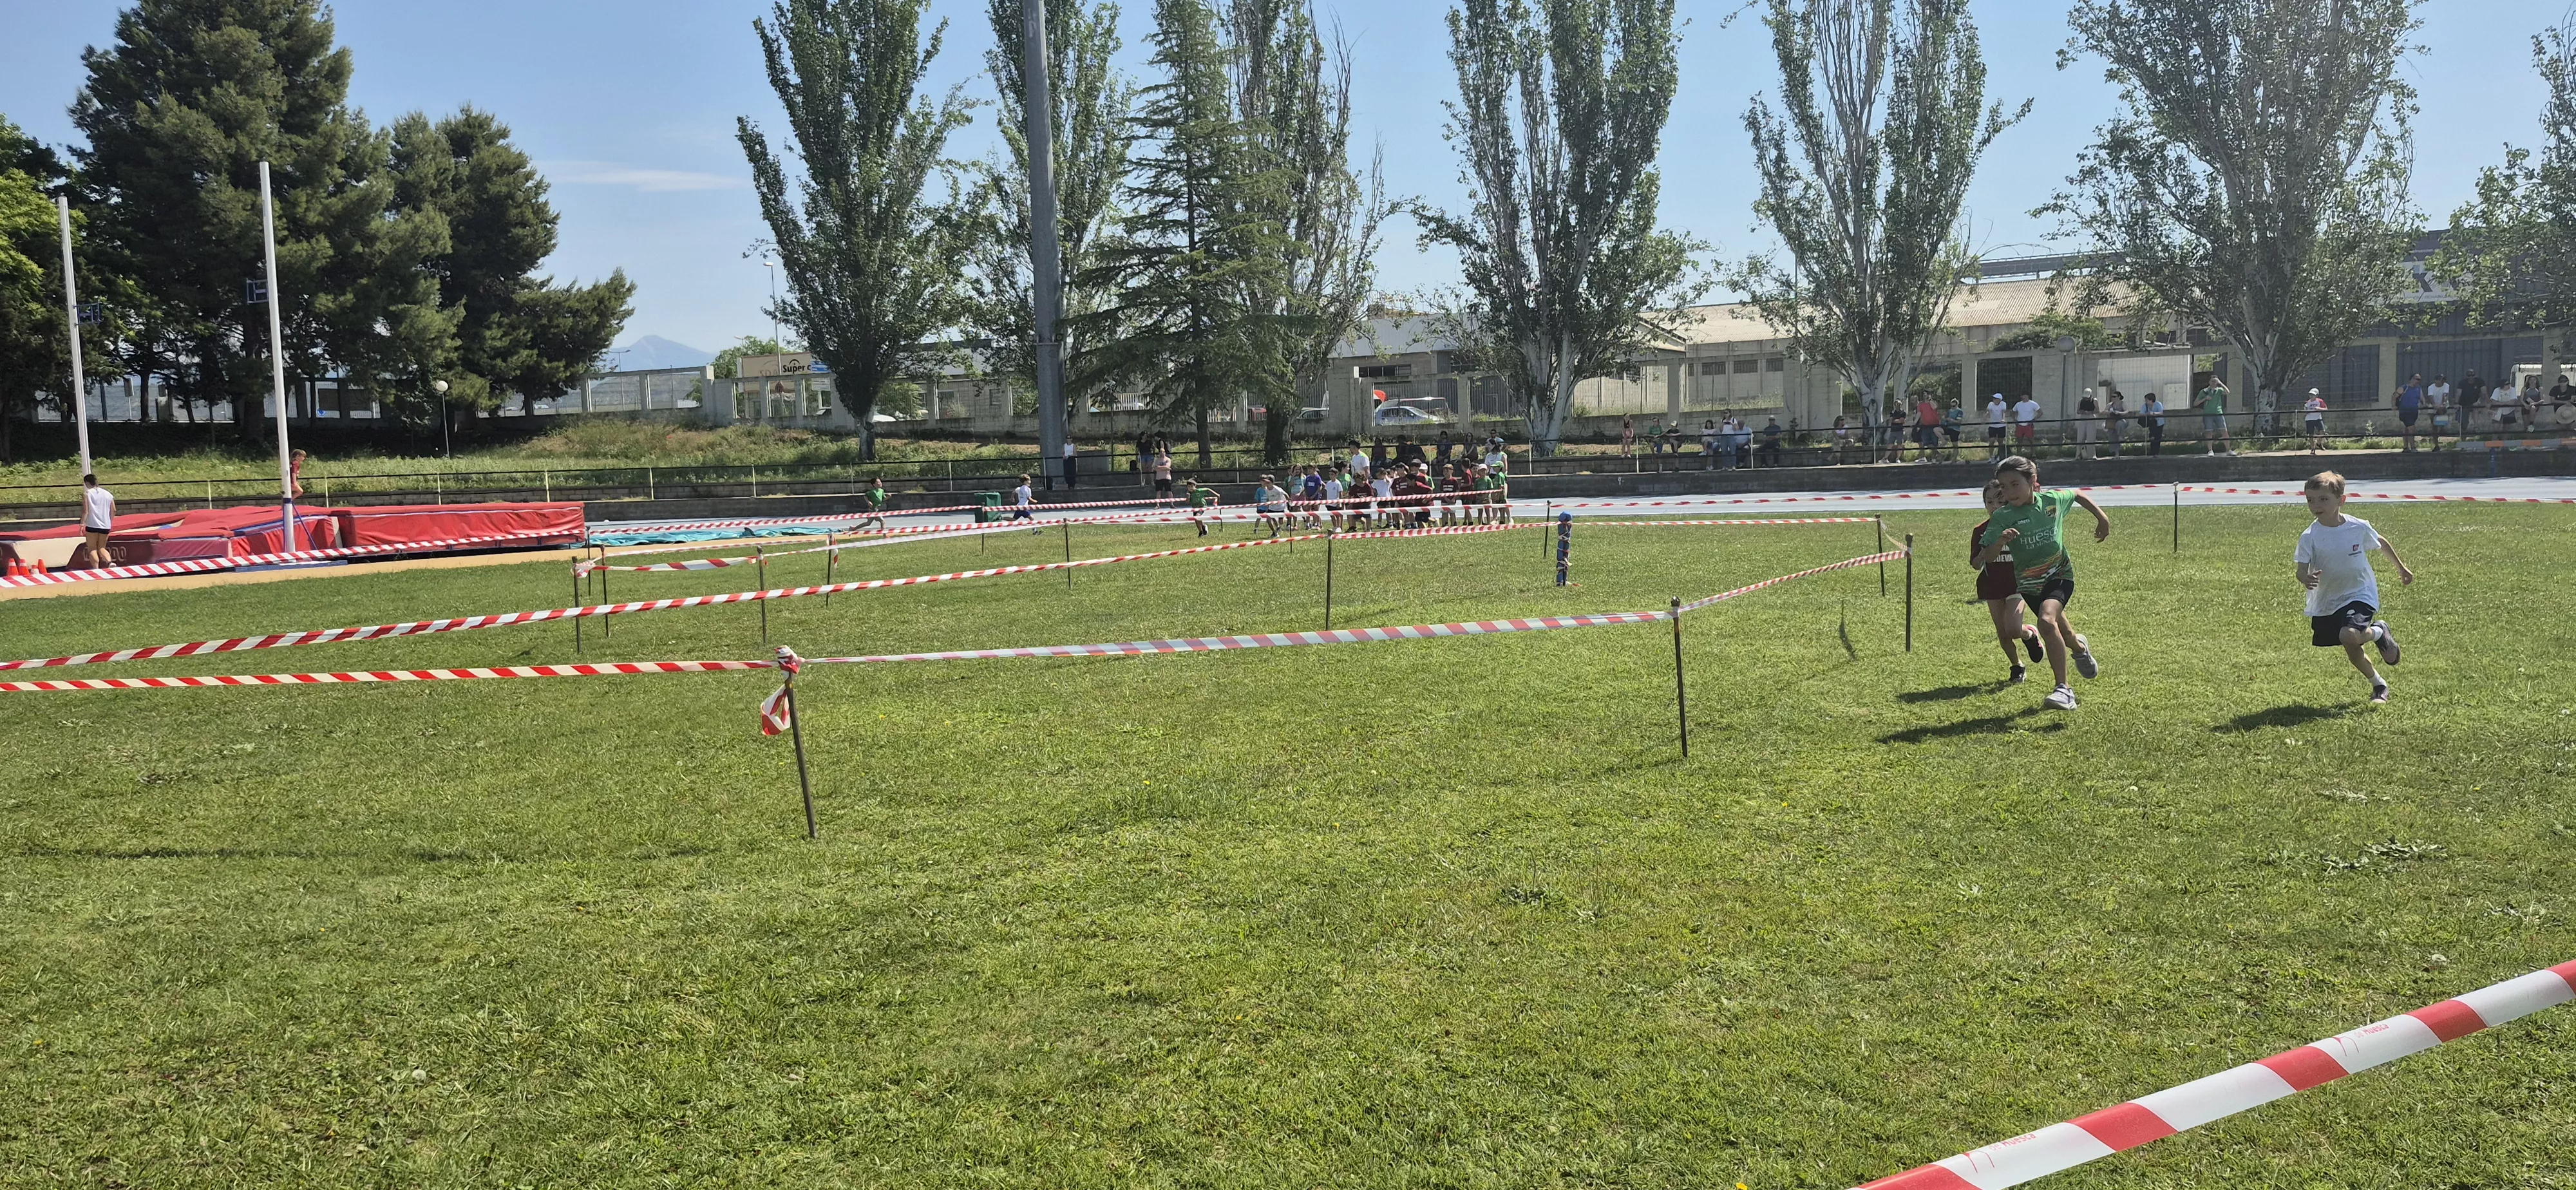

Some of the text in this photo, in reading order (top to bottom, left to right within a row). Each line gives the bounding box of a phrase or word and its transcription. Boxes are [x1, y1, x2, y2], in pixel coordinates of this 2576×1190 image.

[782, 364, 806, 374] Super
[2361, 1023, 2390, 1035] Huesca
[2000, 1133, 2037, 1148] Huesca
